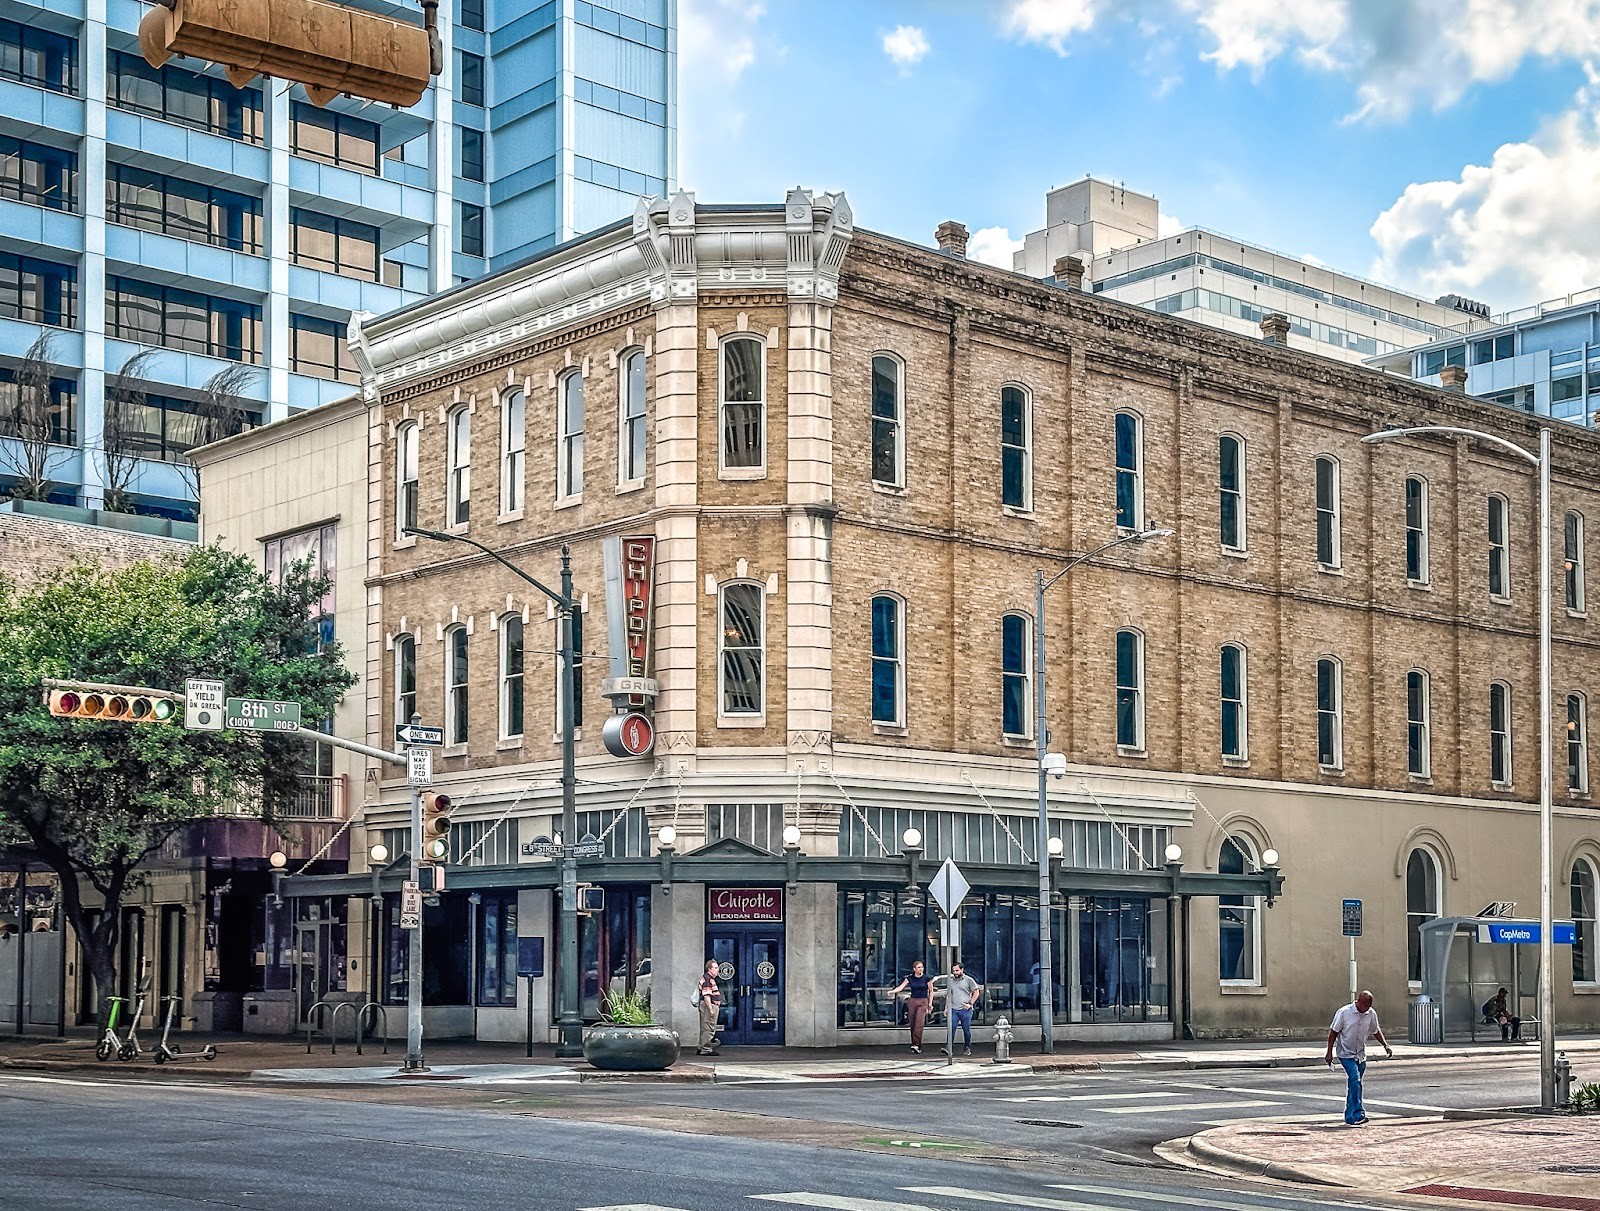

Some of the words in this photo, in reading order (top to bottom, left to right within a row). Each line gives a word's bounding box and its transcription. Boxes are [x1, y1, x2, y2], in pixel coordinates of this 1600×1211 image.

[627, 542, 647, 676] CHIPOTLE
[206, 684, 222, 692] TURN
[620, 680, 658, 692] GRILL
[195, 692, 215, 701] YIELD
[241, 701, 268, 718] 8th
[273, 704, 287, 714] ST
[410, 730, 424, 739] ONE
[424, 732, 438, 740] WAY
[522, 844, 528, 852] E
[537, 845, 561, 853] STREET
[573, 845, 598, 854] CONGRESS
[717, 890, 775, 913] Chipotle
[1499, 928, 1531, 941] CapMetro
